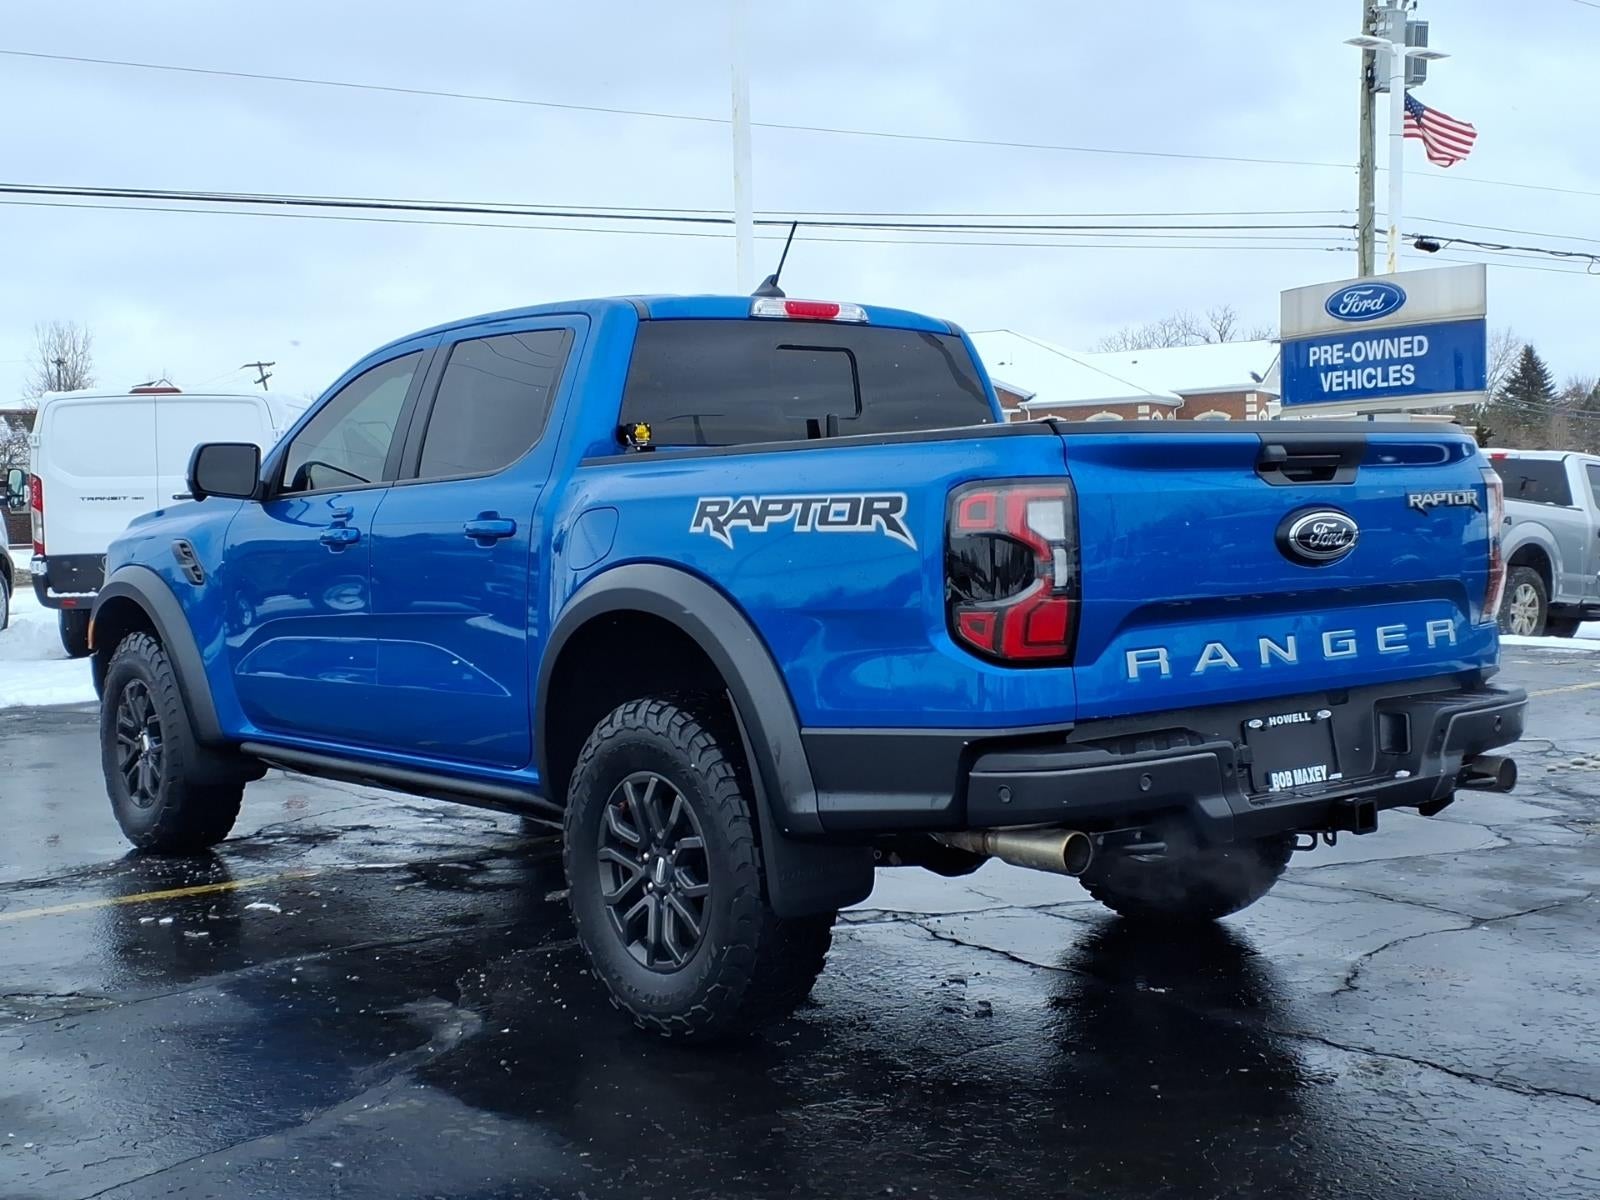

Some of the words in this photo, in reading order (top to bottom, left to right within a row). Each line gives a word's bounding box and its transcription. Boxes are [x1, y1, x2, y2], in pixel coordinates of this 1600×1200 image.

[1339, 289, 1386, 314] Ford
[1309, 335, 1429, 366] PRE-OWNED
[1320, 365, 1415, 392] VEHICLES
[1408, 490, 1481, 513] RAPTOR
[689, 492, 918, 551] RAPTOR
[1309, 521, 1347, 548] Ford
[1126, 619, 1457, 679] RANGER
[1268, 712, 1311, 726] HOWELL
[1271, 769, 1294, 788] BOB
[1293, 765, 1327, 786] MAXEY
